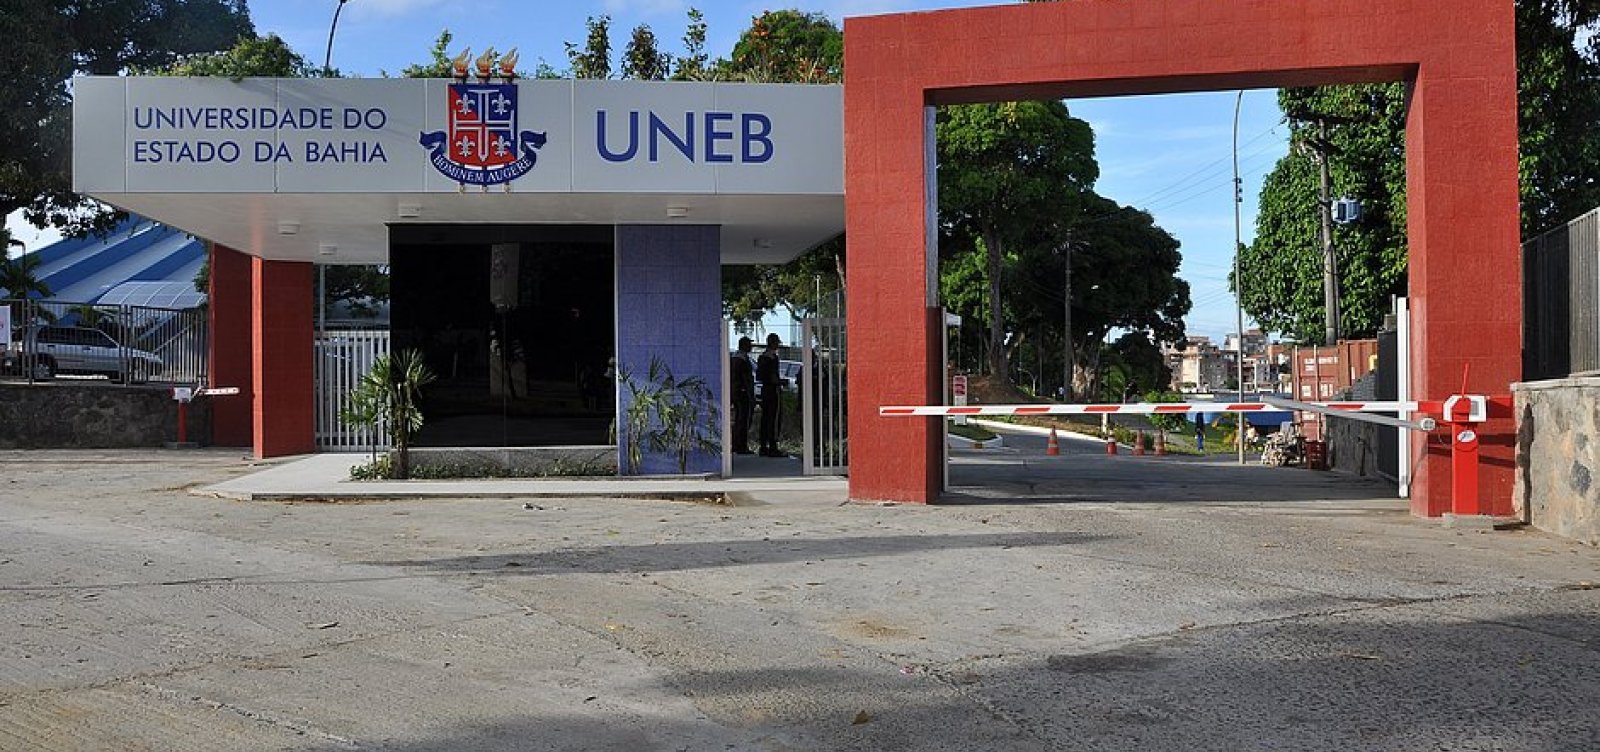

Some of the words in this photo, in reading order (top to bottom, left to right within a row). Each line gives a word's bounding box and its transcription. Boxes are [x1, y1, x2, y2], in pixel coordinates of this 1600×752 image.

[134, 107, 333, 130] UNIVERSIDADE
[343, 108, 387, 130] DO
[596, 110, 774, 164] UNEB
[134, 141, 240, 163] ESTADO
[254, 142, 293, 163] DA
[305, 142, 388, 163] BAHIA
[433, 154, 485, 182] HOMINEM
[488, 158, 532, 182] AUGERE
